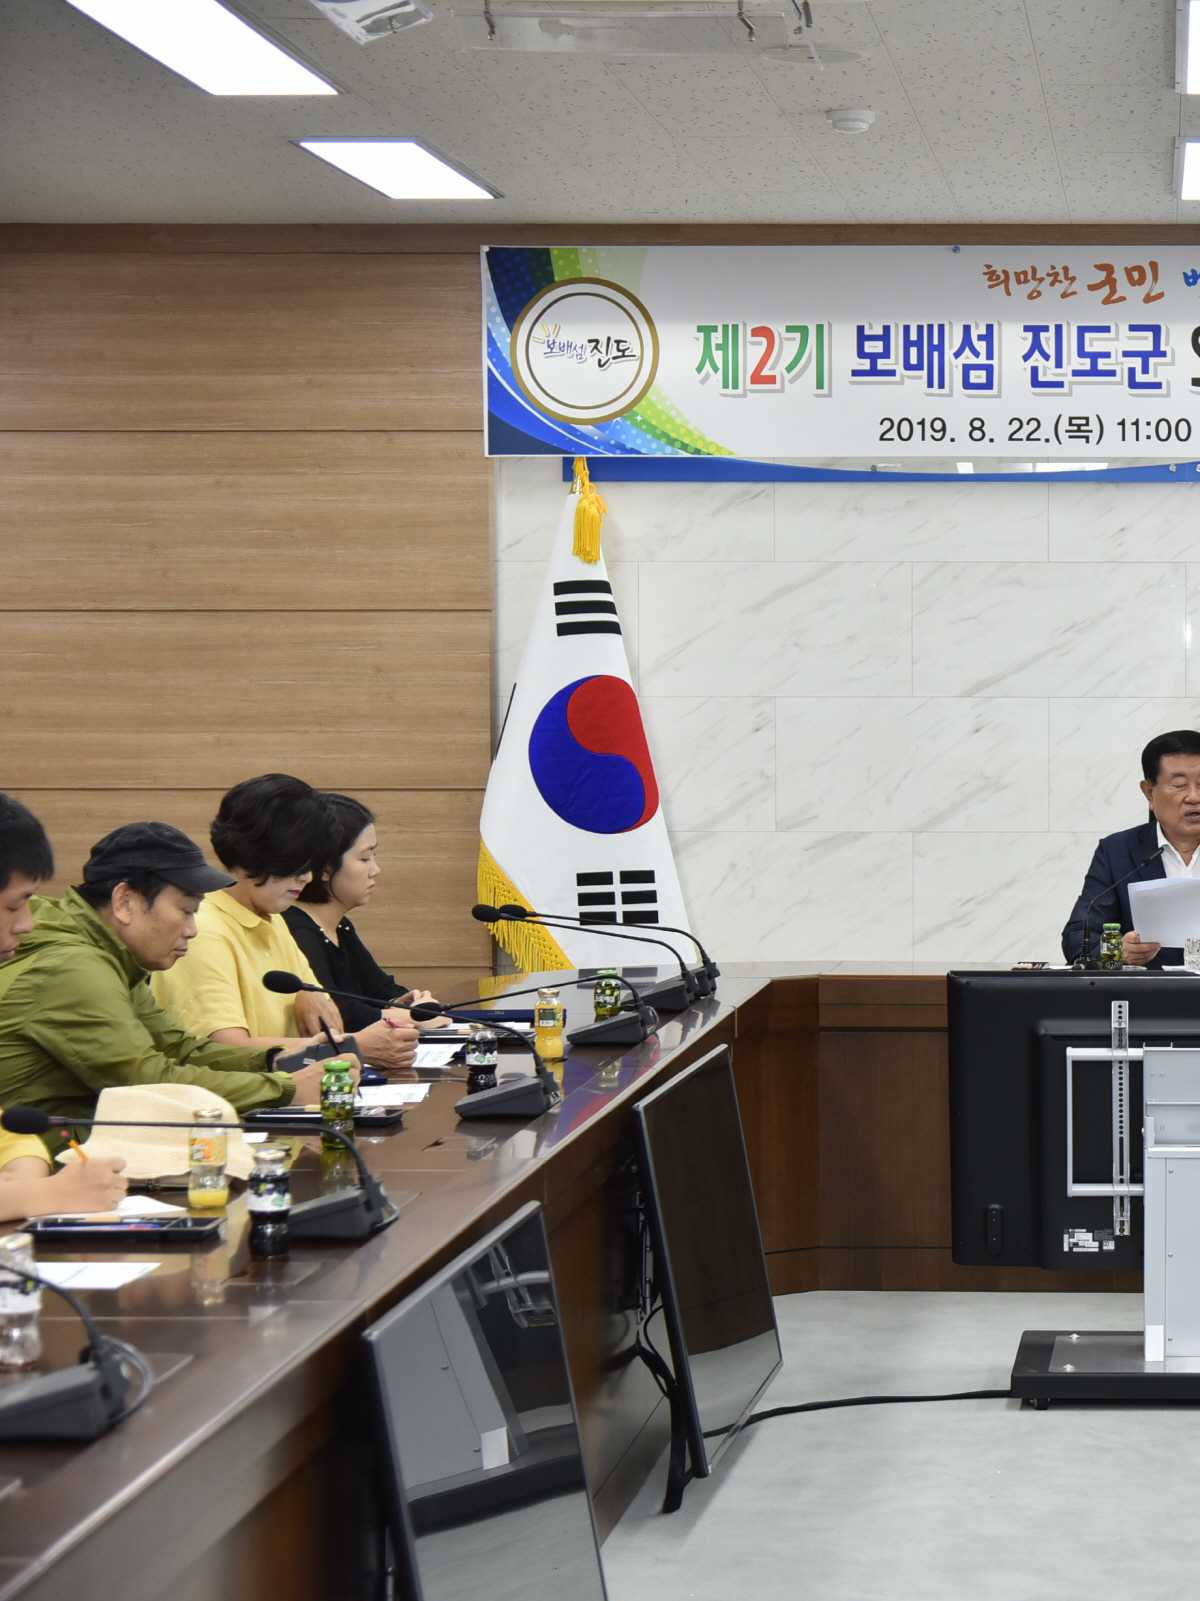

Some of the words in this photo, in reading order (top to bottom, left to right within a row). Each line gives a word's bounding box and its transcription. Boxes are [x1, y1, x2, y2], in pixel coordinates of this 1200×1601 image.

[982, 263, 1078, 300] 희망찬
[1087, 260, 1165, 305] 군민
[543, 338, 585, 361] 보배섬
[587, 335, 637, 368] 진도
[696, 323, 824, 390] 제2기
[850, 323, 995, 390] 보배섬
[1020, 323, 1167, 390] 진도군
[878, 416, 956, 443] 2019.
[968, 416, 995, 443] 8.
[1007, 413, 1105, 445] 22.(목)
[1116, 416, 1193, 442] 11:00
